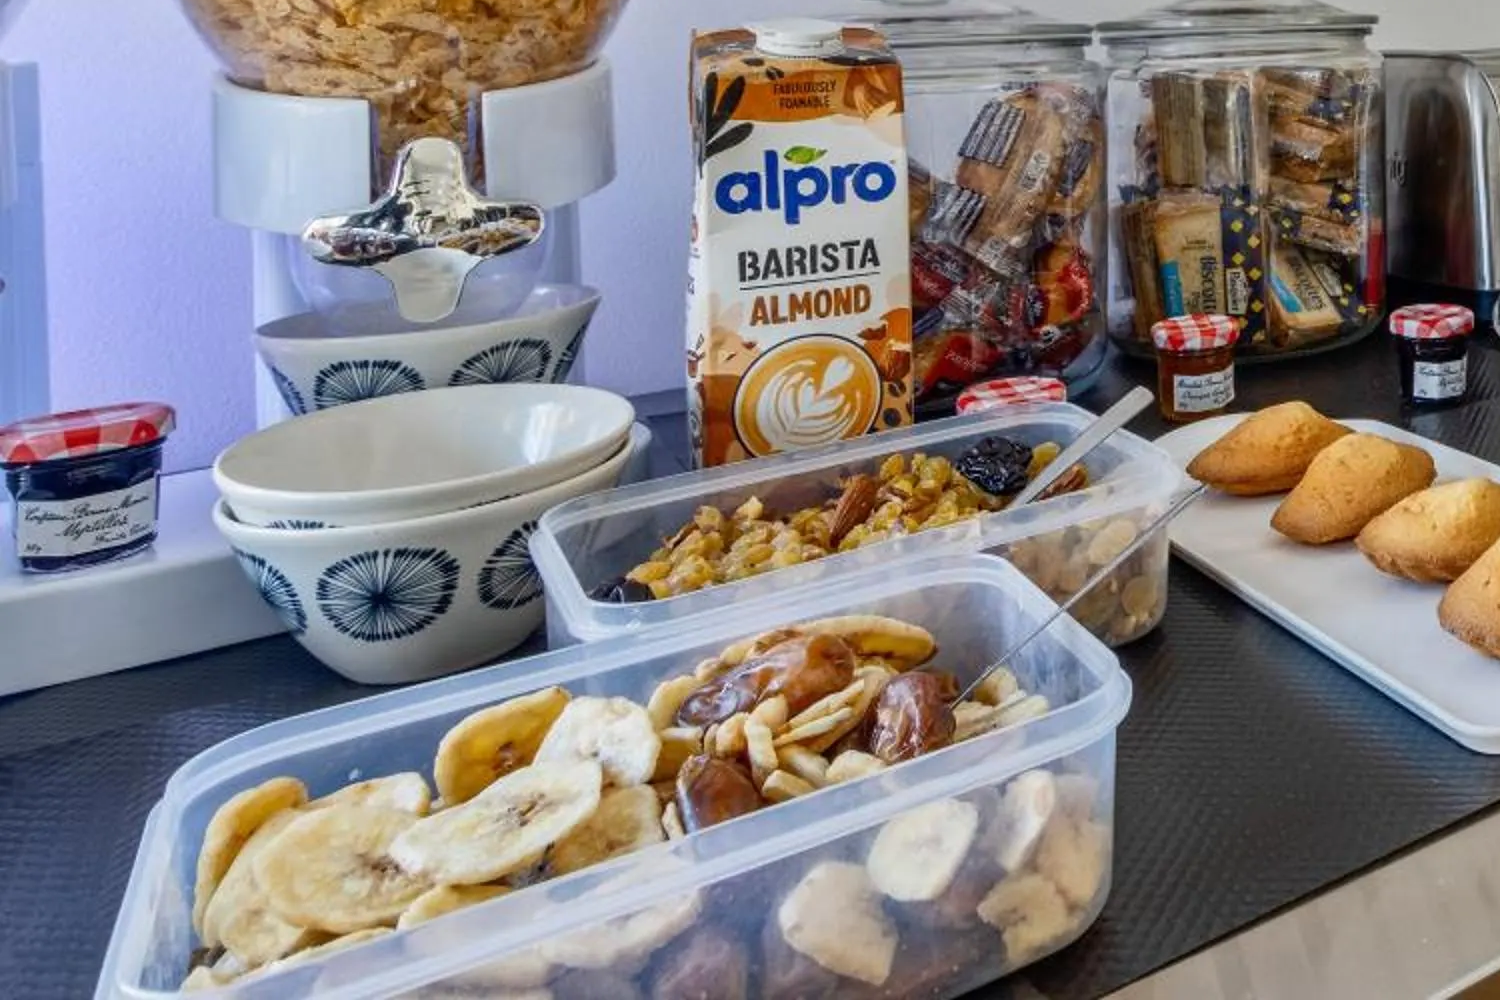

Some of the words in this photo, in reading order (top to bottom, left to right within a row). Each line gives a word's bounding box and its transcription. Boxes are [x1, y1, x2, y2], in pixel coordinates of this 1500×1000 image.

[715, 149, 897, 225] alpro
[738, 237, 881, 283] BARISTA
[749, 283, 872, 327] ALMOND
